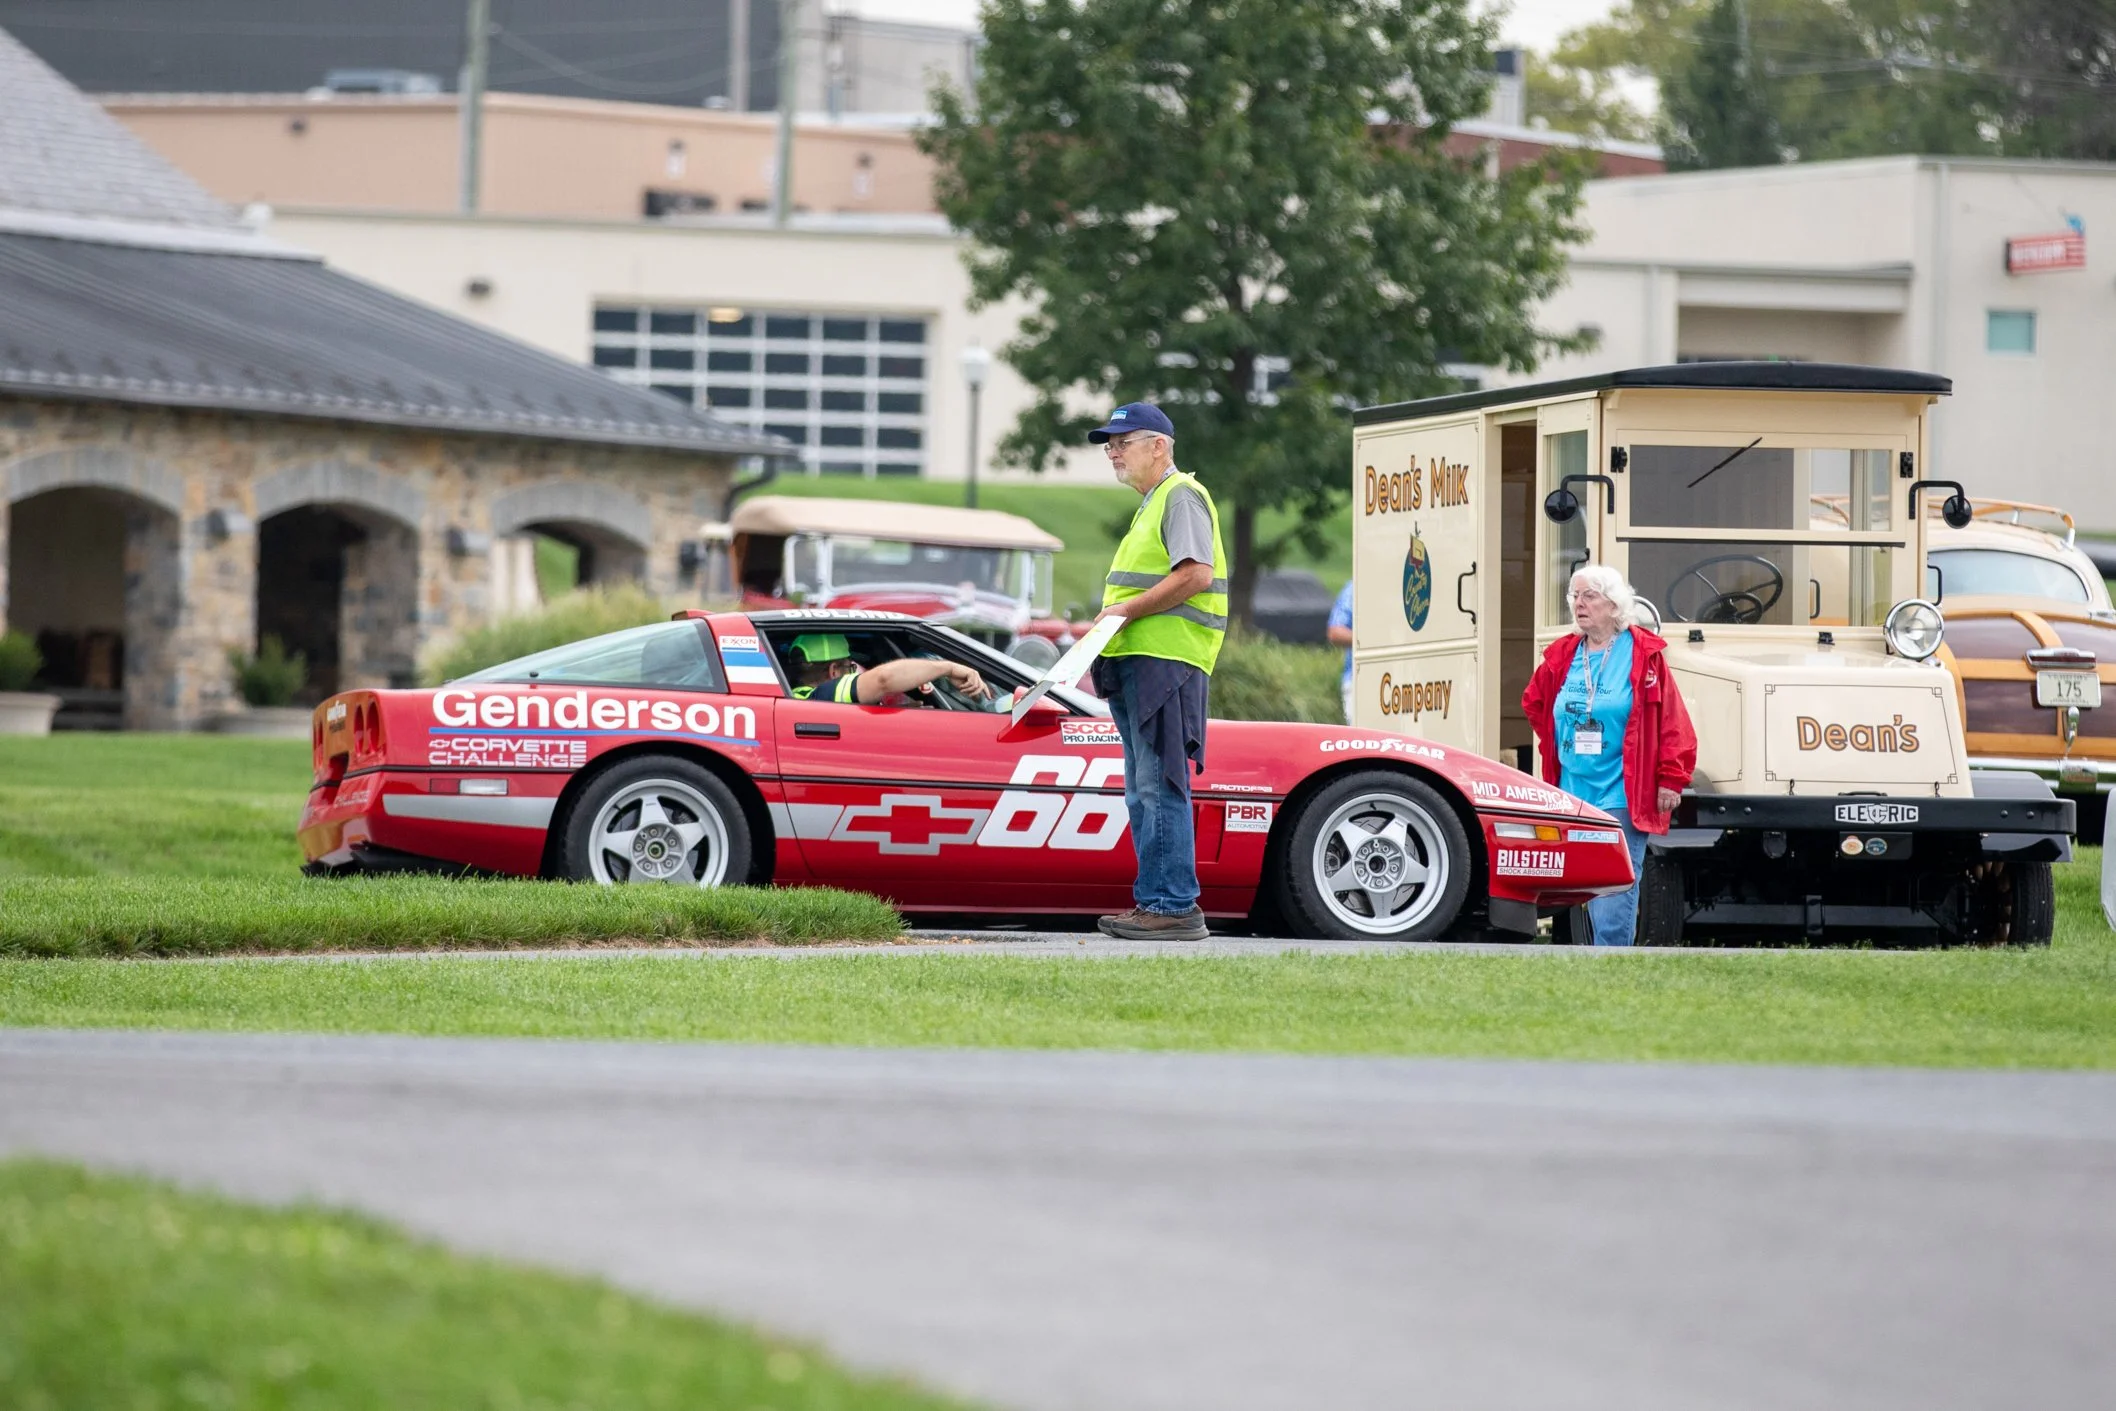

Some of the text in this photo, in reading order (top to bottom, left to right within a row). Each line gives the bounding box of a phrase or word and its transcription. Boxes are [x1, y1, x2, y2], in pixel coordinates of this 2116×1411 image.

[1365, 455, 1422, 516] Dean's
[722, 637, 757, 646] EXXON
[1380, 672, 1453, 722] Company
[2057, 680, 2082, 698] 175
[432, 690, 756, 739] Genderson
[1063, 735, 1085, 743] PRO
[1797, 715, 1920, 752] Dean's
[451, 738, 587, 753] CORVETTE
[1319, 738, 1446, 760] GOODYEAR
[429, 752, 587, 767] CHALLENGE
[1471, 781, 1573, 806] MID AMERICA
[1227, 804, 1267, 820] PBR
[1497, 849, 1566, 869] BILSTEIN
[1522, 869, 1562, 877] ABSORBERS
